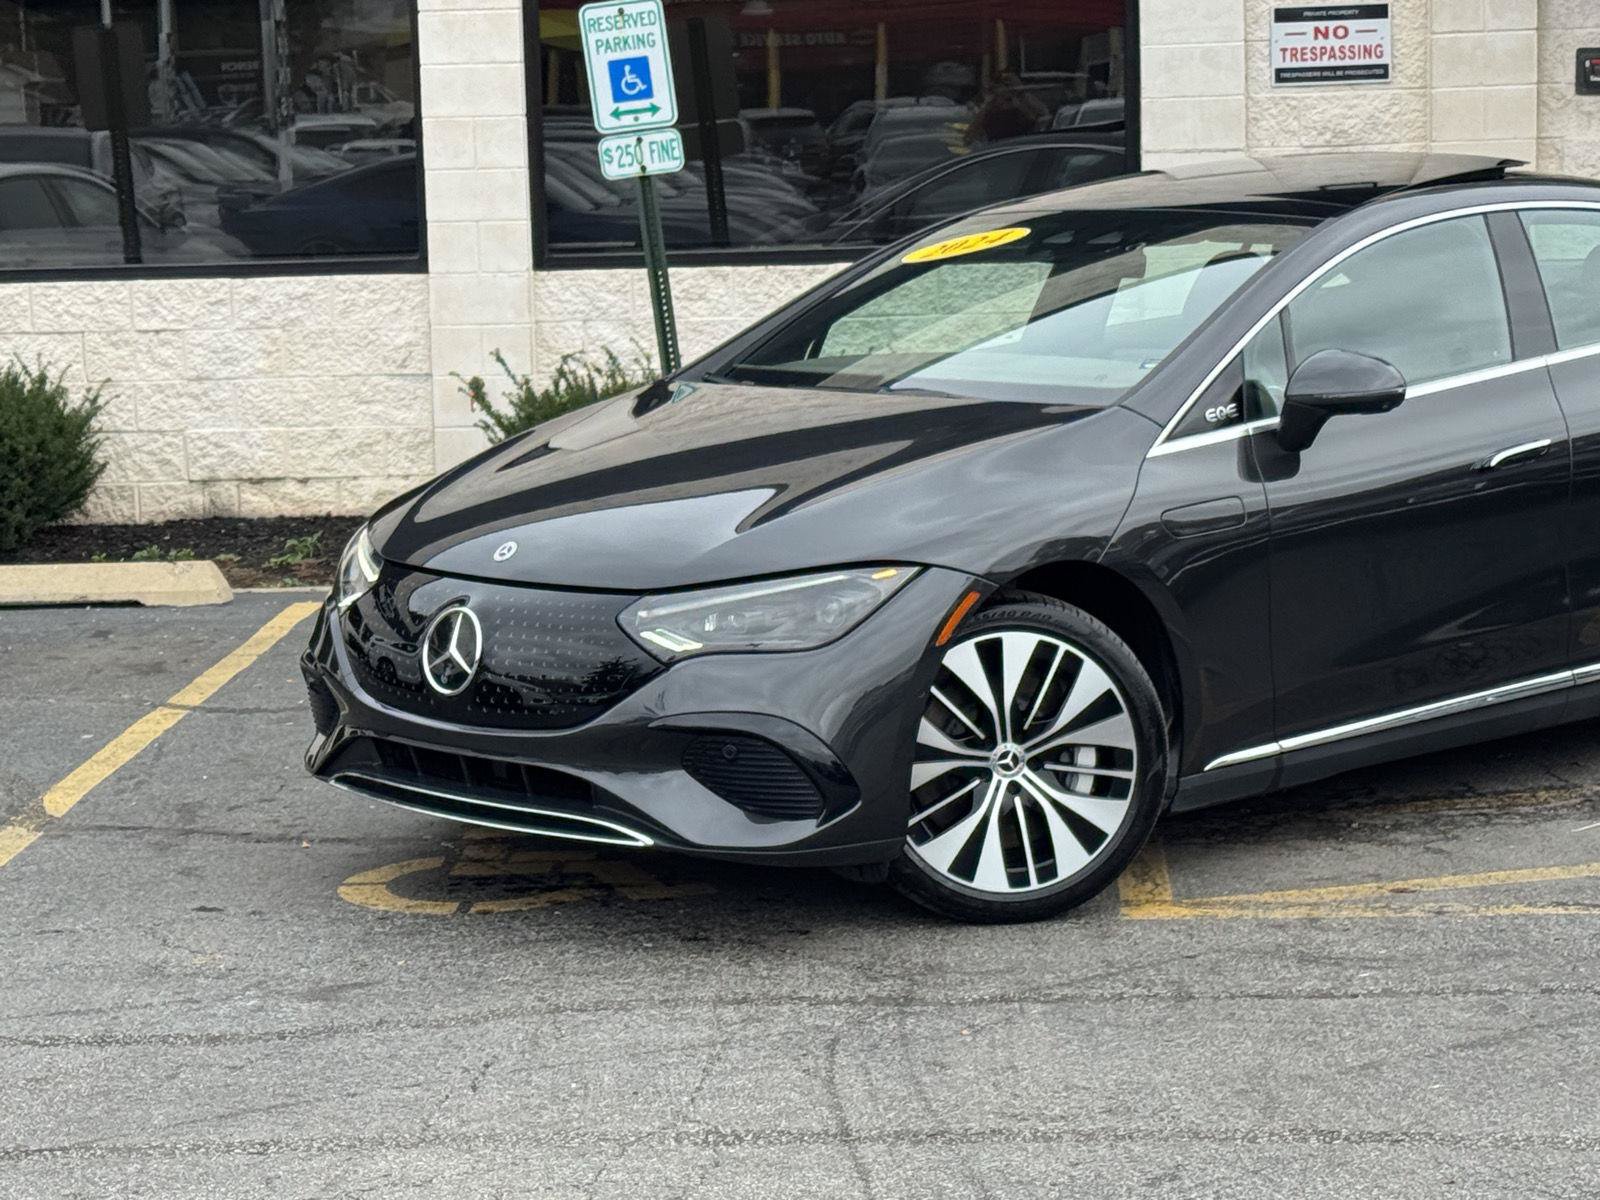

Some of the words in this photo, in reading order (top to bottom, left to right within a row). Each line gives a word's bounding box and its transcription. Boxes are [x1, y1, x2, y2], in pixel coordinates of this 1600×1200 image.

[588, 10, 657, 33] RESERVED
[1313, 25, 1349, 40] NO
[596, 33, 656, 55] PARKING
[1280, 44, 1384, 63] TRESPASSING
[649, 138, 681, 163] FINE
[1205, 404, 1239, 422] EQE
